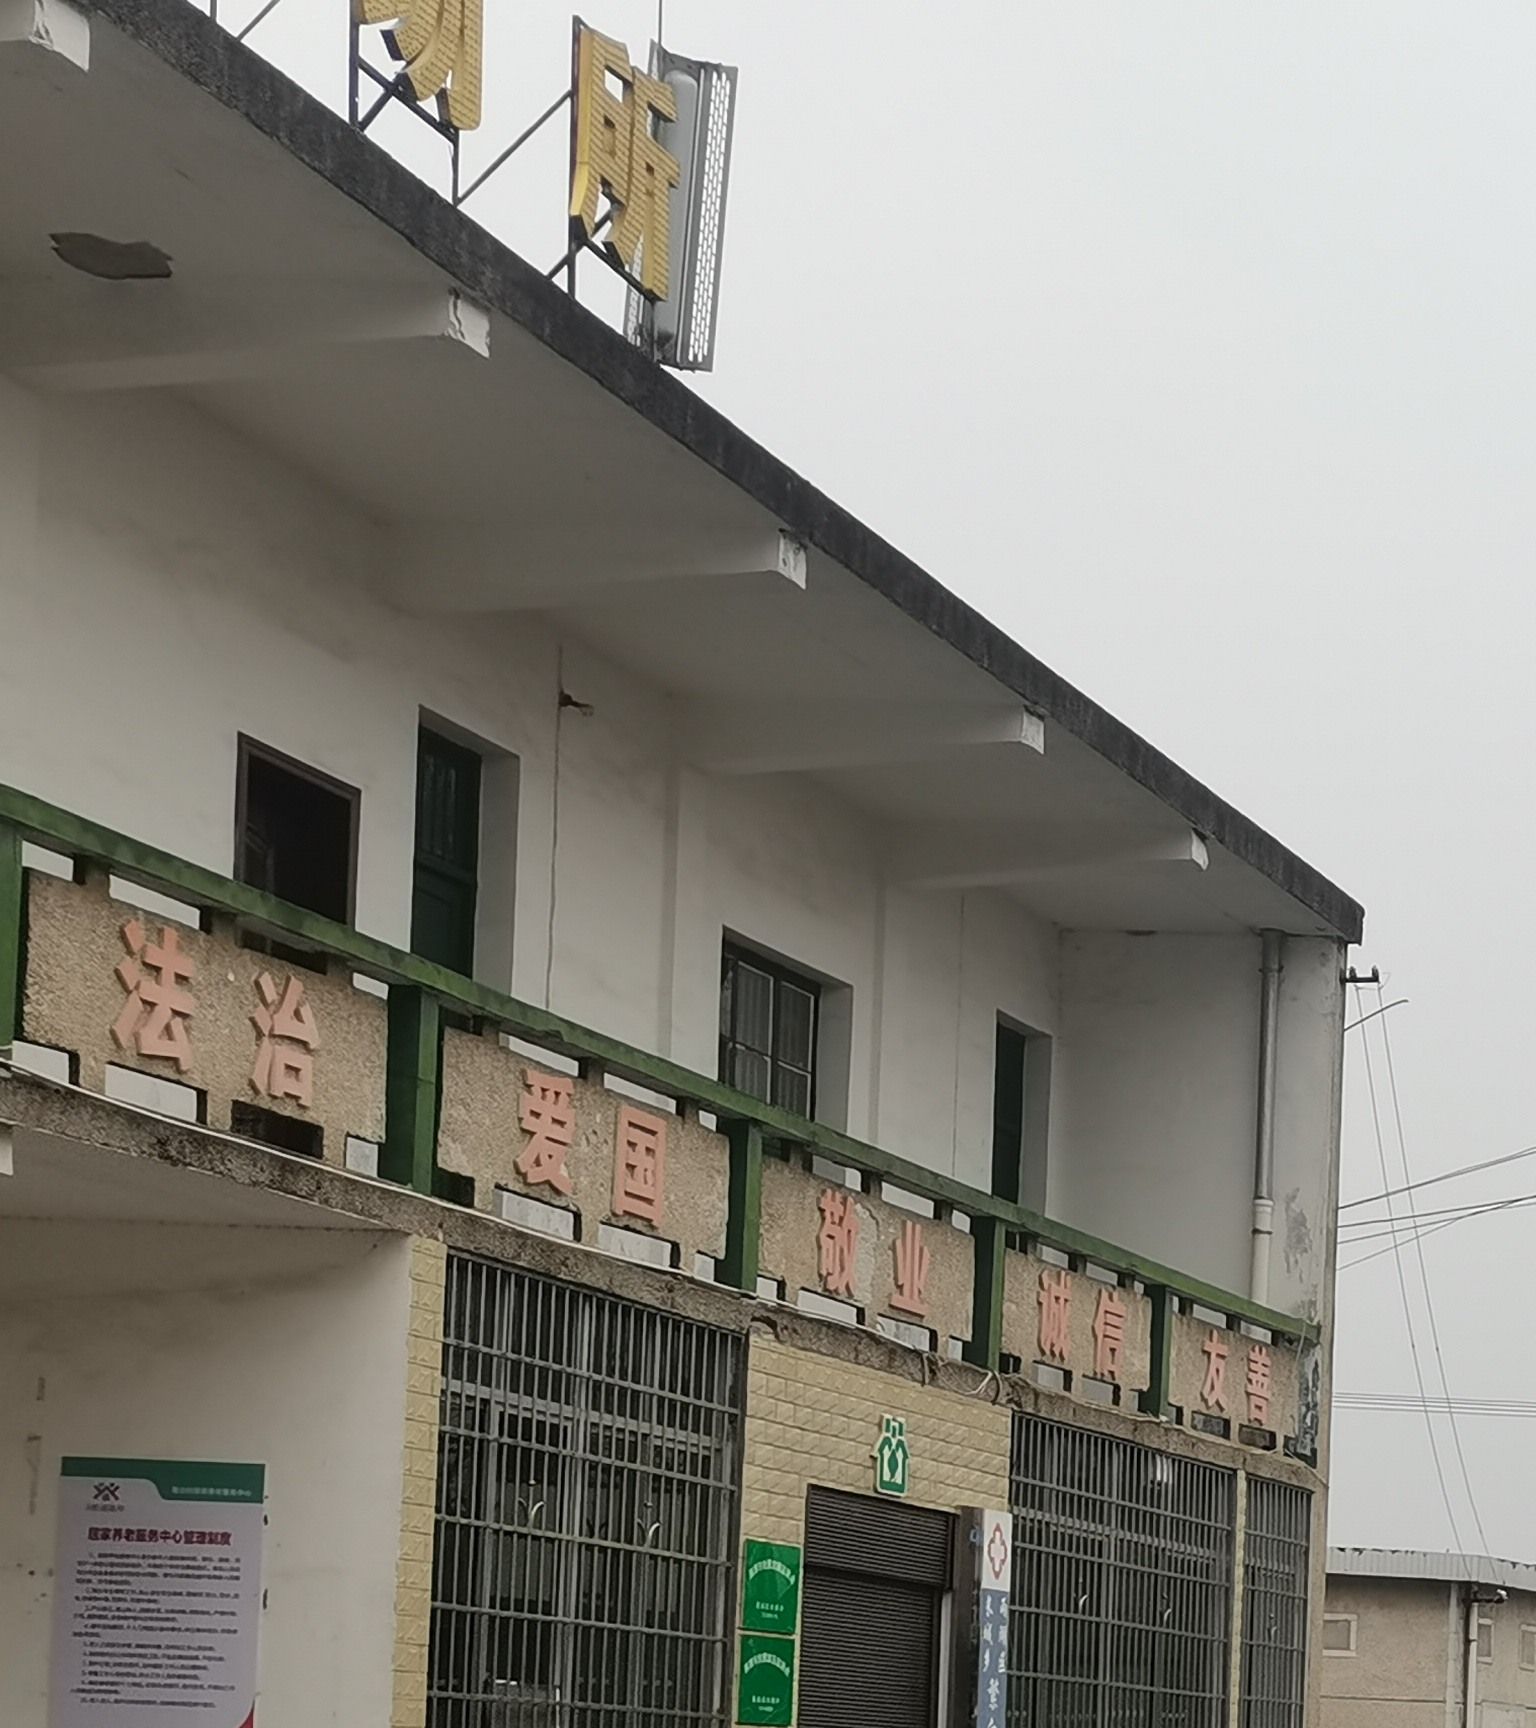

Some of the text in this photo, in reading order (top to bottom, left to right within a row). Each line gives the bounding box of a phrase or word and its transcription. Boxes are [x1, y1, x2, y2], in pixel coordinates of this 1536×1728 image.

[111, 918, 1272, 1427] 法治 爱国 敬业 诚信 友善
